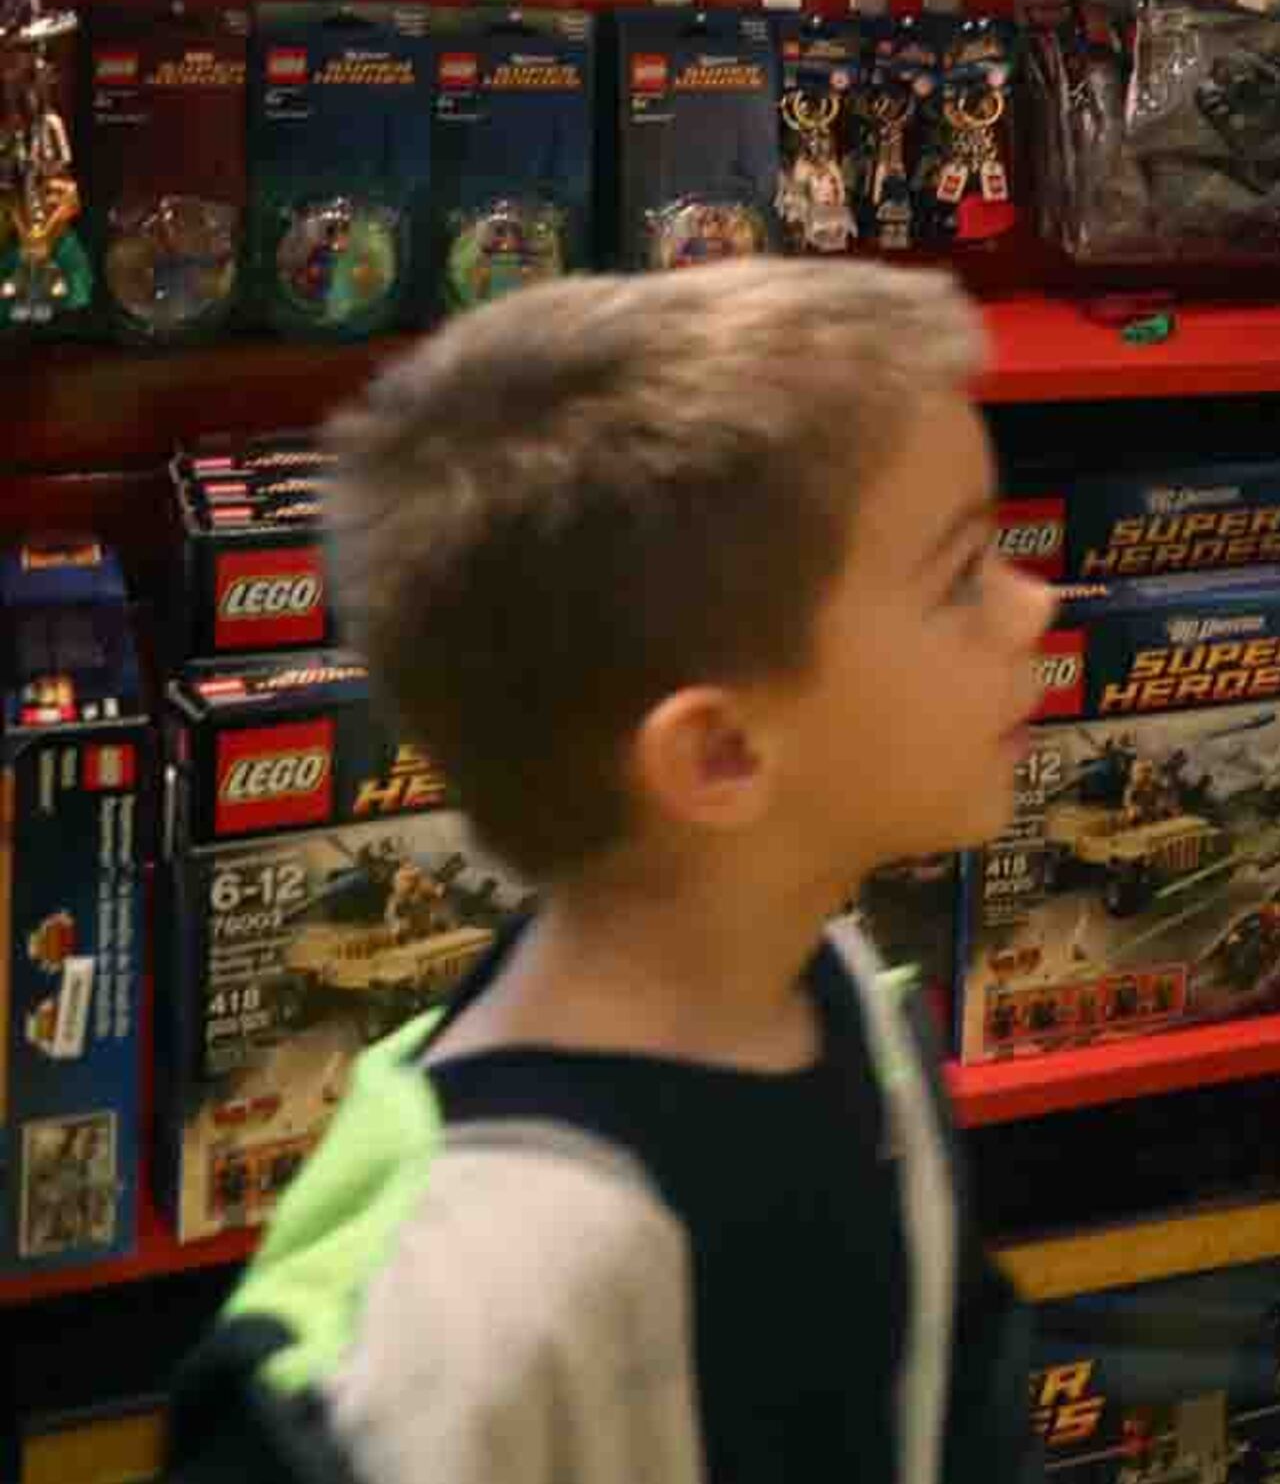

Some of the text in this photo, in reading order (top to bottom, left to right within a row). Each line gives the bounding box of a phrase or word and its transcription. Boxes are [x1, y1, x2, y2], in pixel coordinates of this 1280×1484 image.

[222, 572, 325, 618] LEGO
[219, 752, 330, 802] LEGO
[1013, 752, 1061, 784] -12
[211, 865, 305, 909] 6-12
